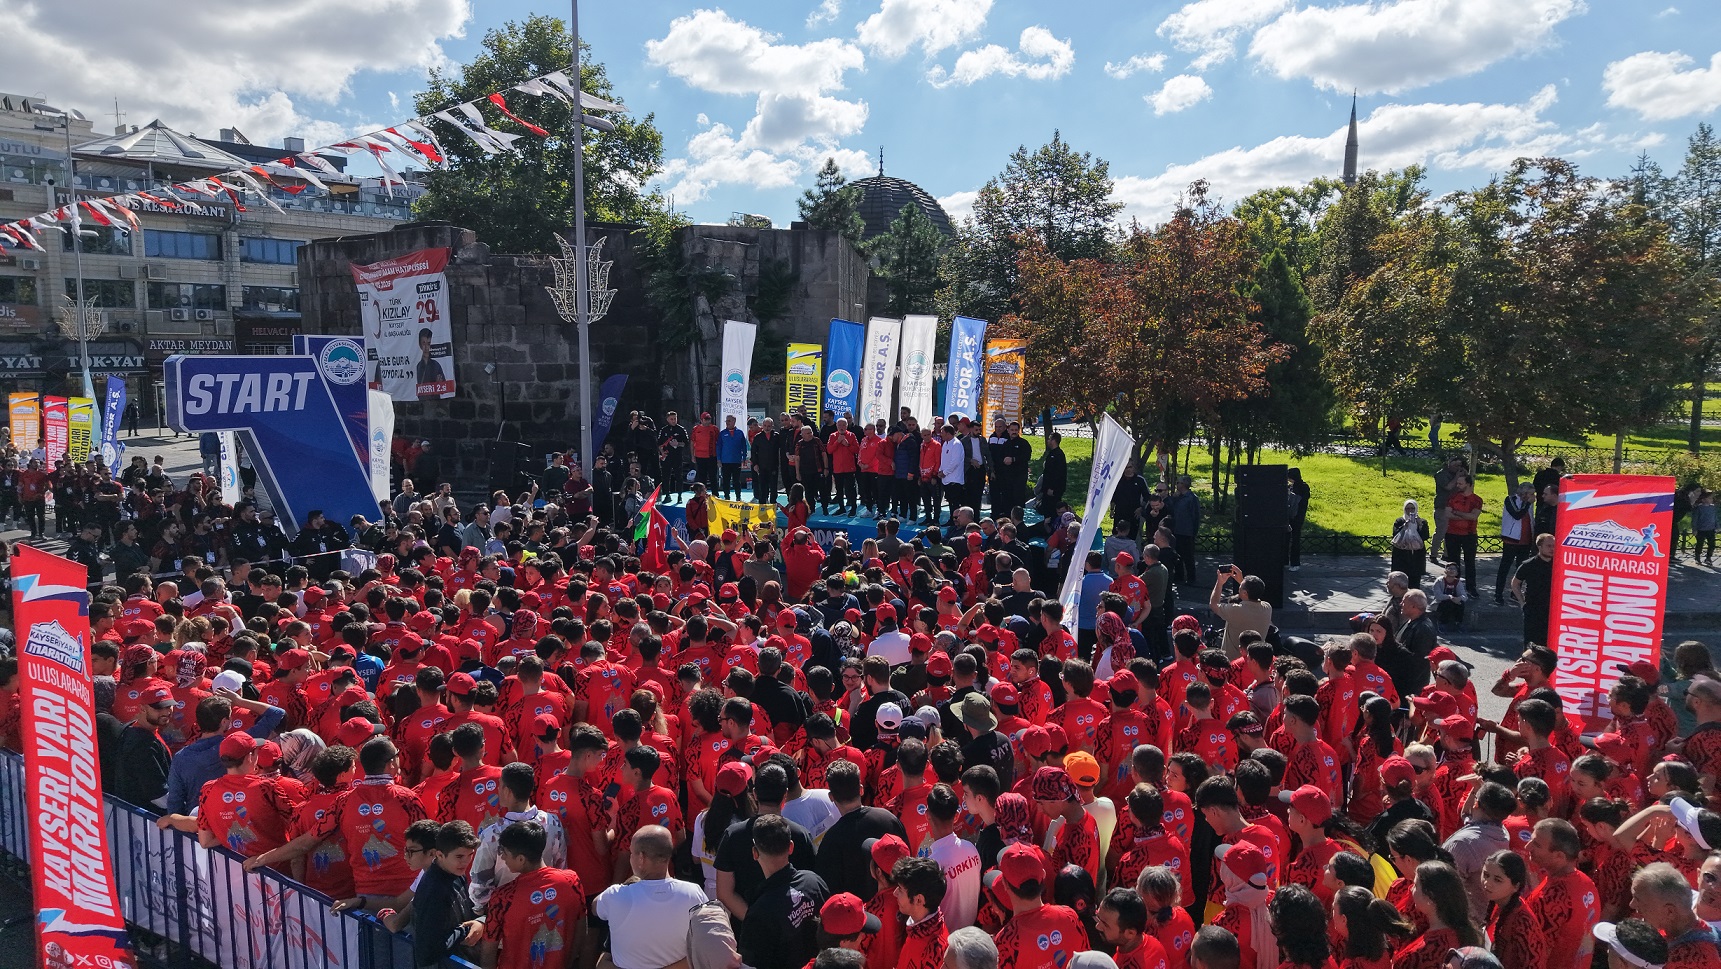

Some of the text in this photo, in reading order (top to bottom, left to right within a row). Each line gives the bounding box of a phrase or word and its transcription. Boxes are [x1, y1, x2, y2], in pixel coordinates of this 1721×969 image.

[382, 305, 411, 319] KIZILAY
[252, 327, 288, 336] HELVACI
[150, 340, 233, 350] AKTAR MEYDAN
[878, 332, 892, 358] A.Ş.
[67, 356, 145, 368] TOK-YAT
[957, 334, 978, 409] SPOR A.Ş.
[874, 361, 886, 398] SPOR
[186, 371, 316, 416] START
[789, 383, 802, 405] YARI
[71, 428, 81, 445] YARI
[1566, 537, 1644, 554] MARATONU
[1563, 551, 1660, 575] ULUSLARARASI
[1560, 569, 1604, 621] YARI
[28, 642, 82, 672] MARATONU
[28, 662, 91, 708] ULUSLARARASI
[32, 687, 72, 900] KAYSERİ YARI
[66, 699, 115, 917] MARATONU
